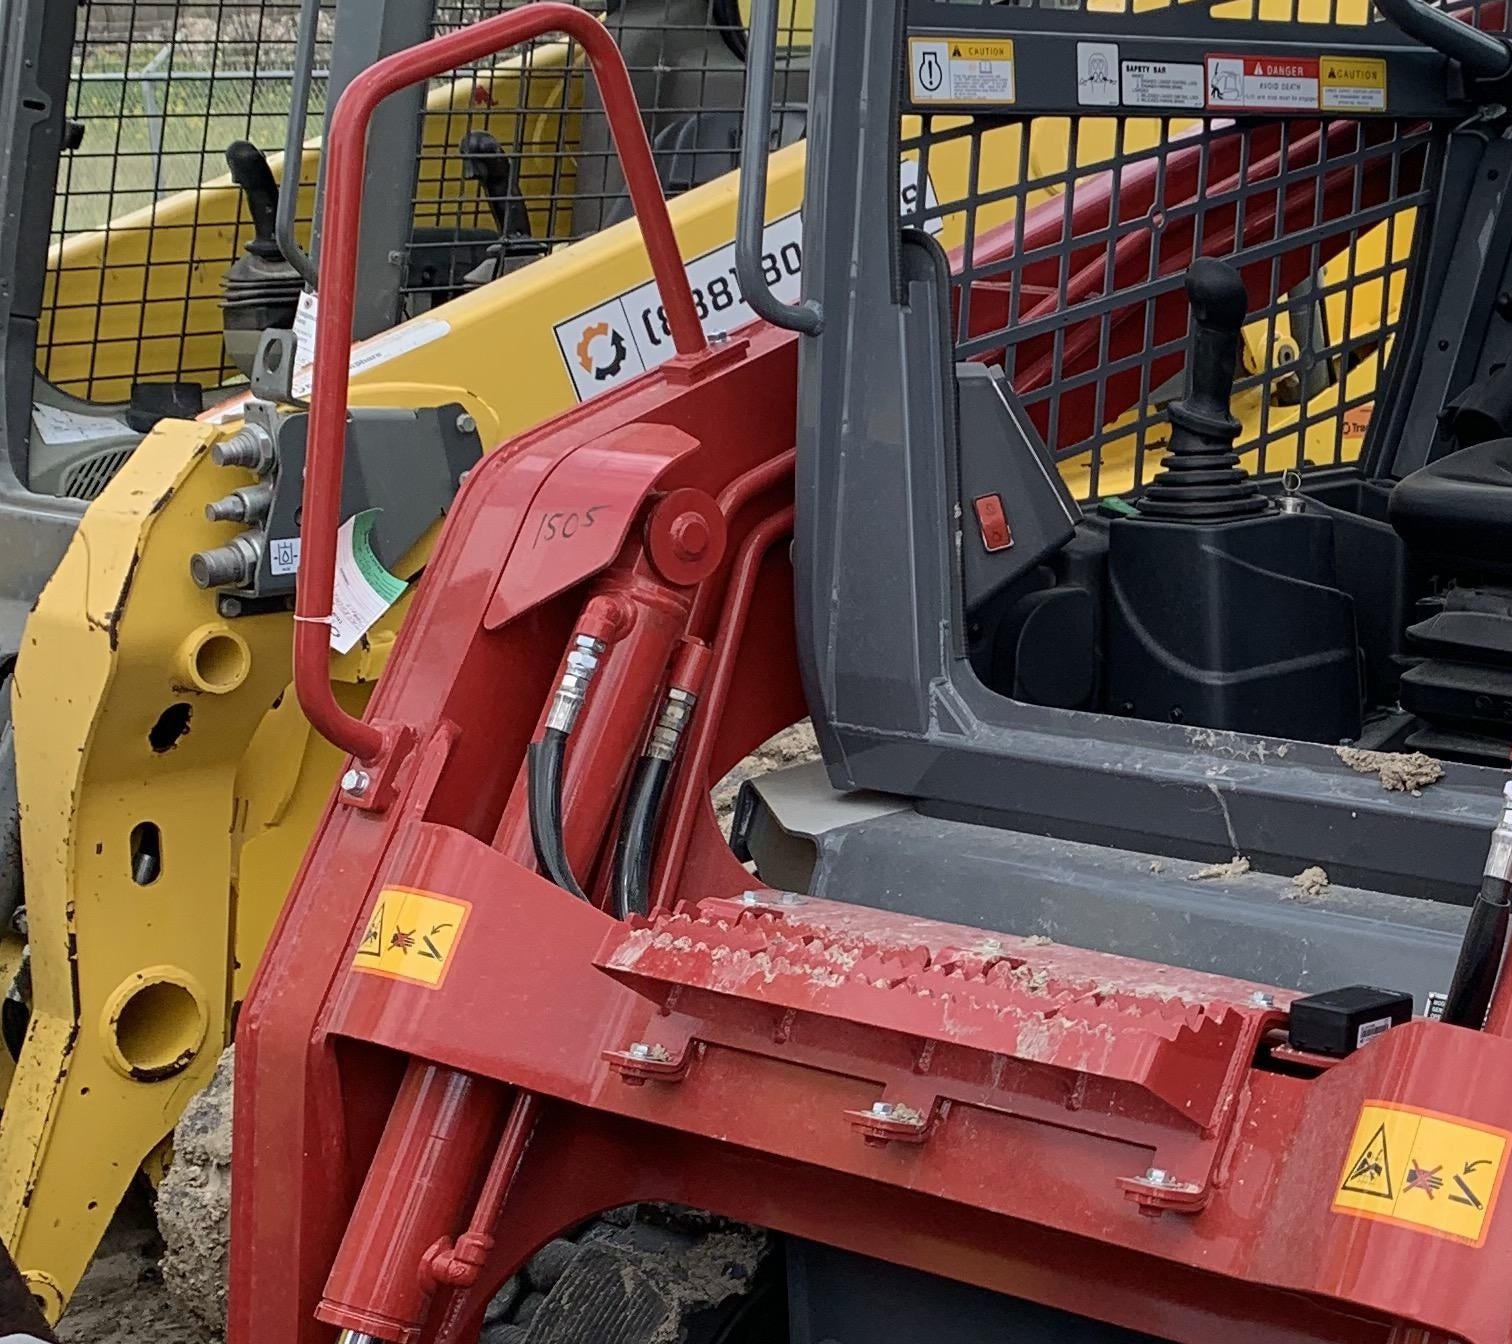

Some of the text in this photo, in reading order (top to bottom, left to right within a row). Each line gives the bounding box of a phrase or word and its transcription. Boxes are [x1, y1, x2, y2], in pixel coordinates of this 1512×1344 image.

[968, 47, 1005, 57] CAUTION
[1153, 66, 1167, 74] BAR
[1266, 65, 1304, 77] DANGER
[1337, 69, 1377, 80] CAUTION
[532, 504, 613, 549] 1505
